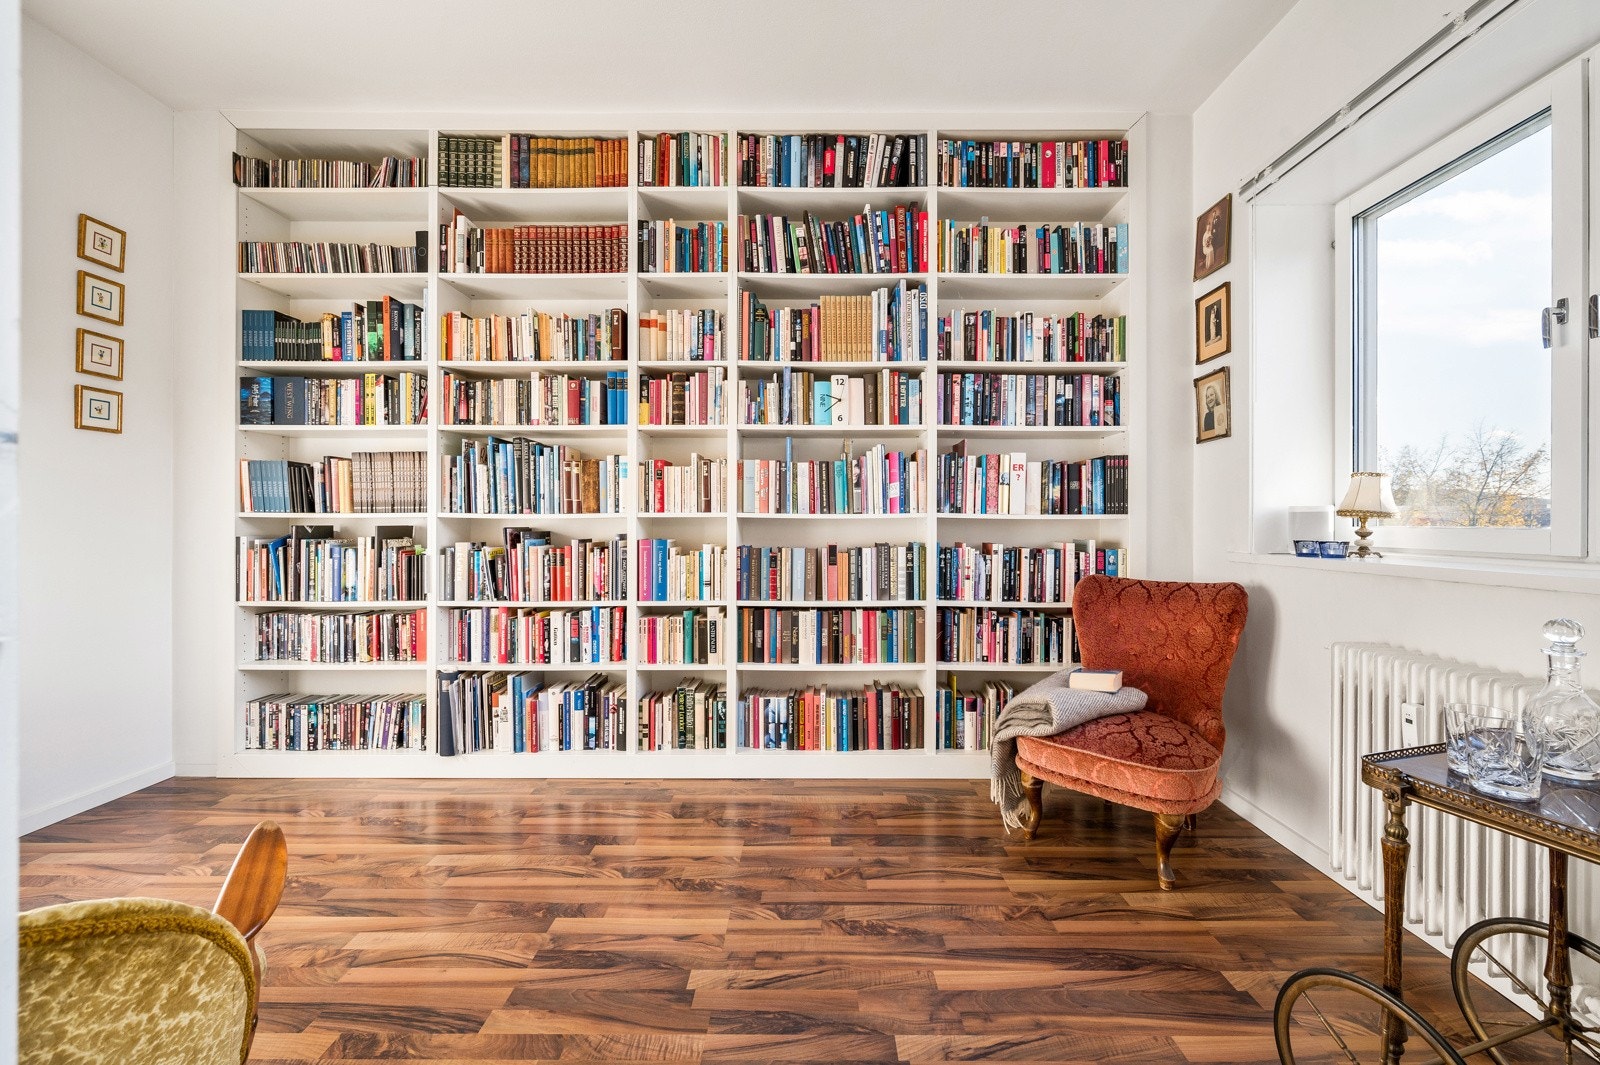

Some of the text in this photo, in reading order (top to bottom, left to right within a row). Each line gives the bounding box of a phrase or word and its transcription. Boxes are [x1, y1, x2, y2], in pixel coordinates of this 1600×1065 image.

[920, 292, 928, 309] OSLO
[835, 378, 845, 386] 12
[837, 414, 843, 422] 6
[1012, 463, 1025, 472] ER
